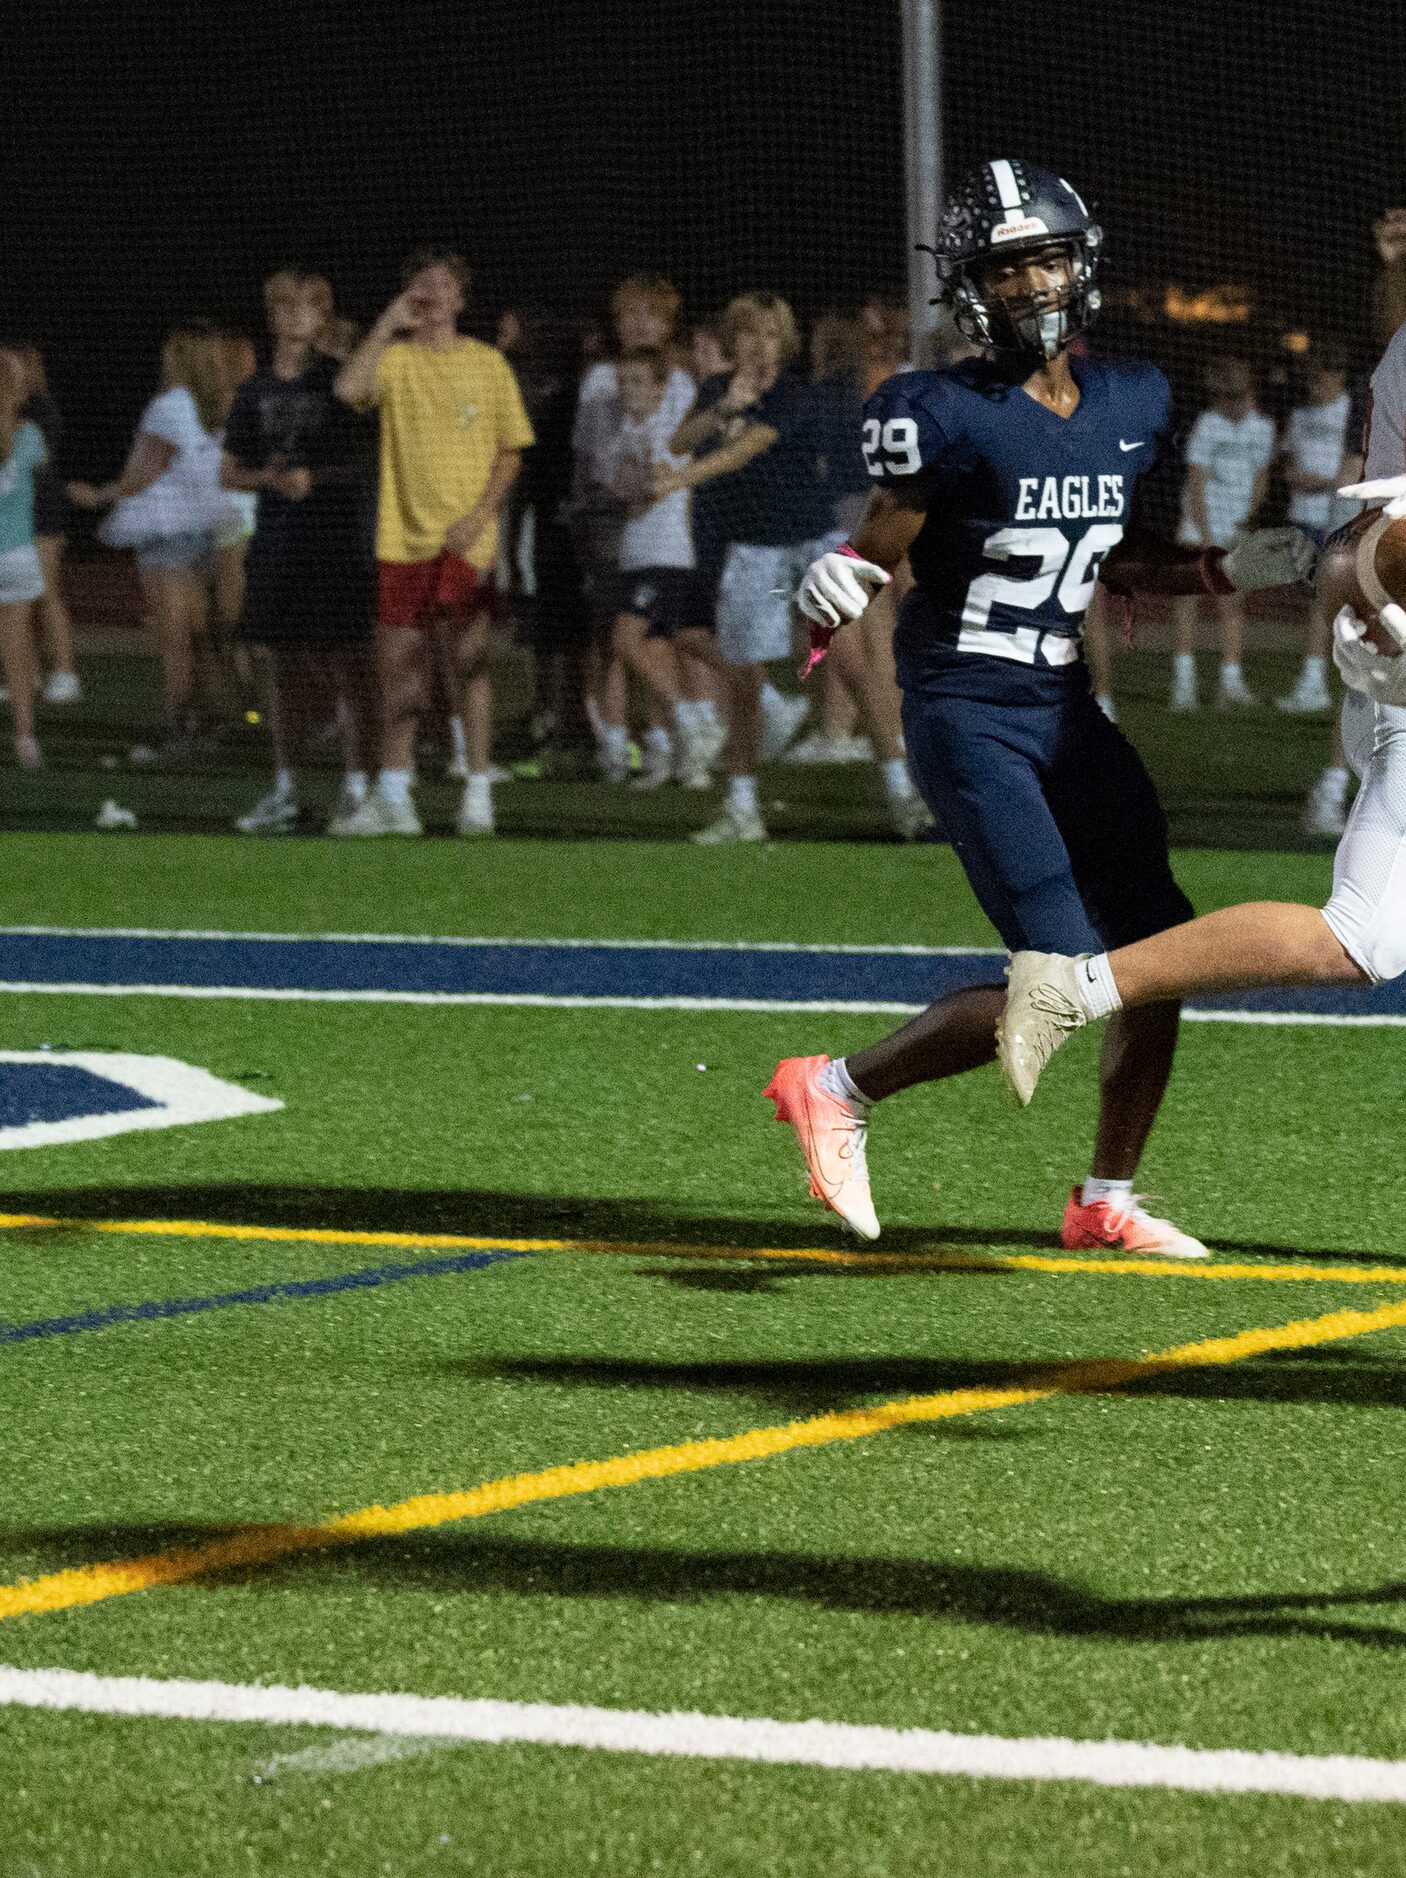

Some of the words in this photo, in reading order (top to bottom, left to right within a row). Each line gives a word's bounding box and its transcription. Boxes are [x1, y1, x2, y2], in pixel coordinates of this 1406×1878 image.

[861, 417, 923, 477] 29
[1014, 474, 1124, 520] EAGLES
[957, 523, 1124, 667] 29
